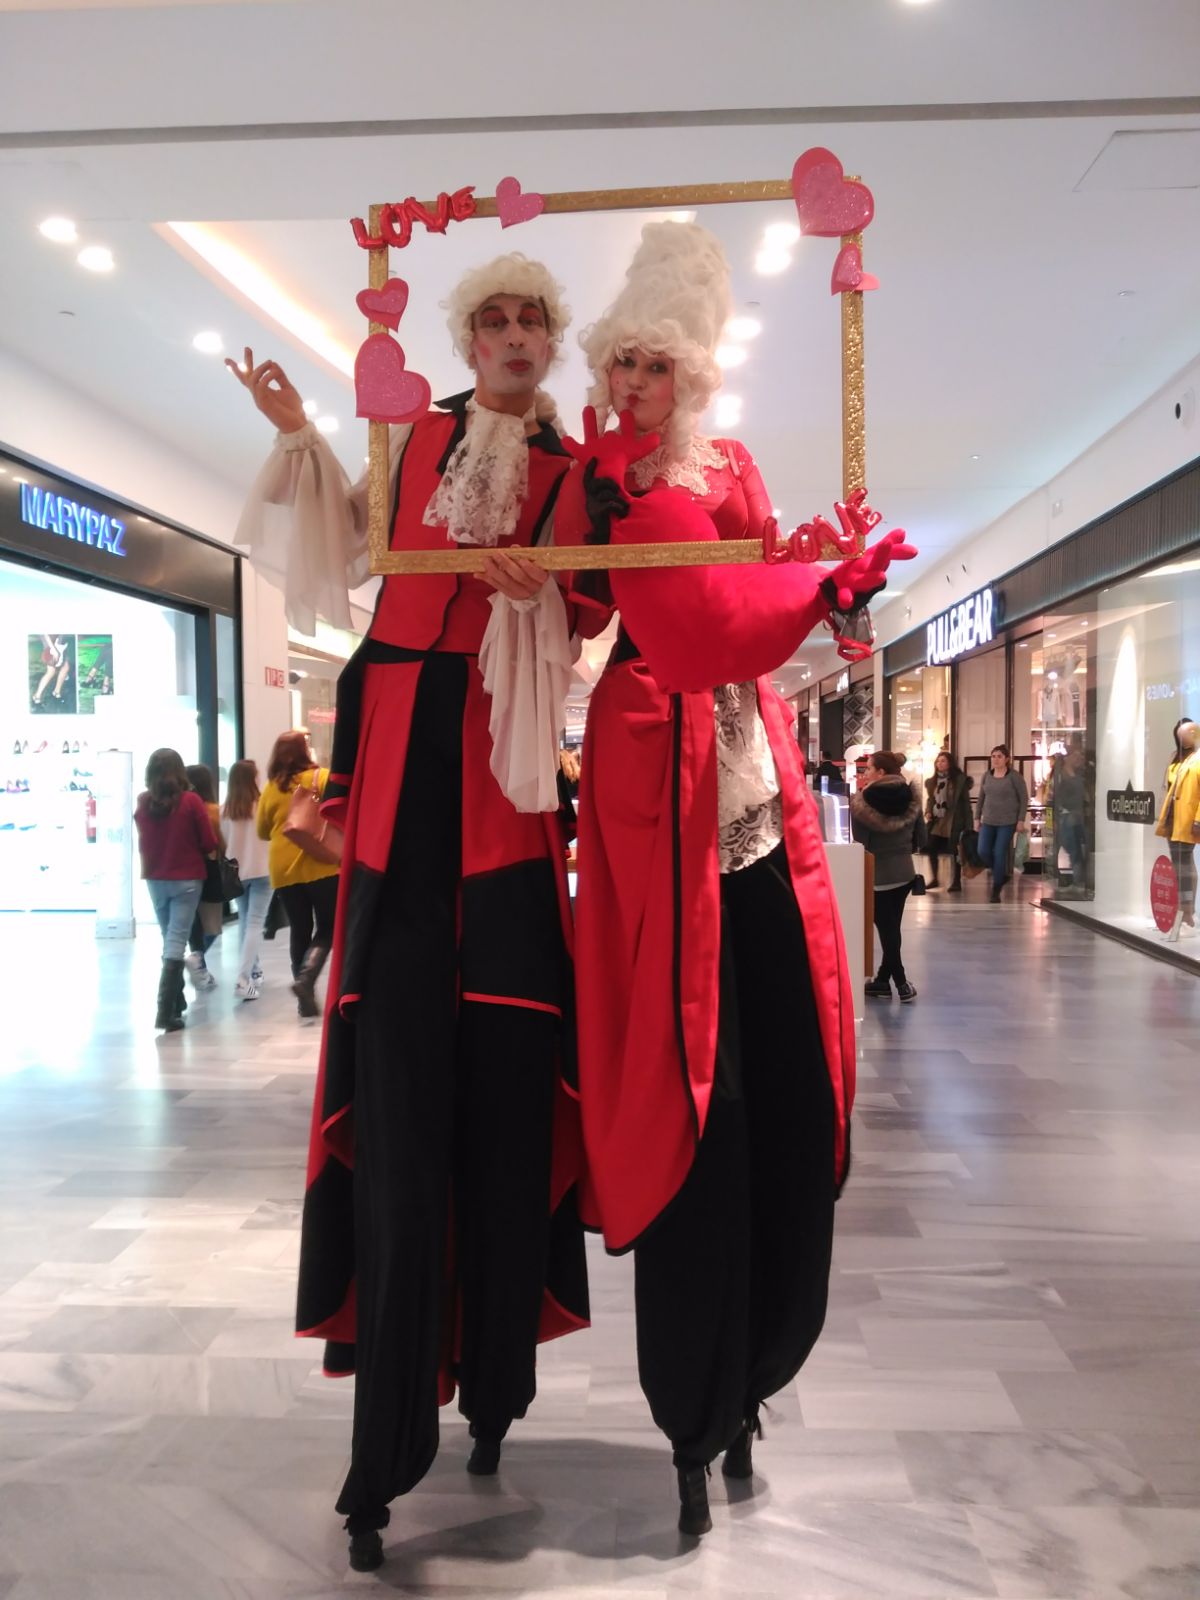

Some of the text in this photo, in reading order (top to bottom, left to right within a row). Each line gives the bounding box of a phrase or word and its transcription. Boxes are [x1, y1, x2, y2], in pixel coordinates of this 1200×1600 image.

[350, 186, 476, 249] LOVE
[20, 482, 126, 557] MARYPAZ
[763, 487, 882, 565] LOVE
[927, 588, 993, 667] PULL&BEAR
